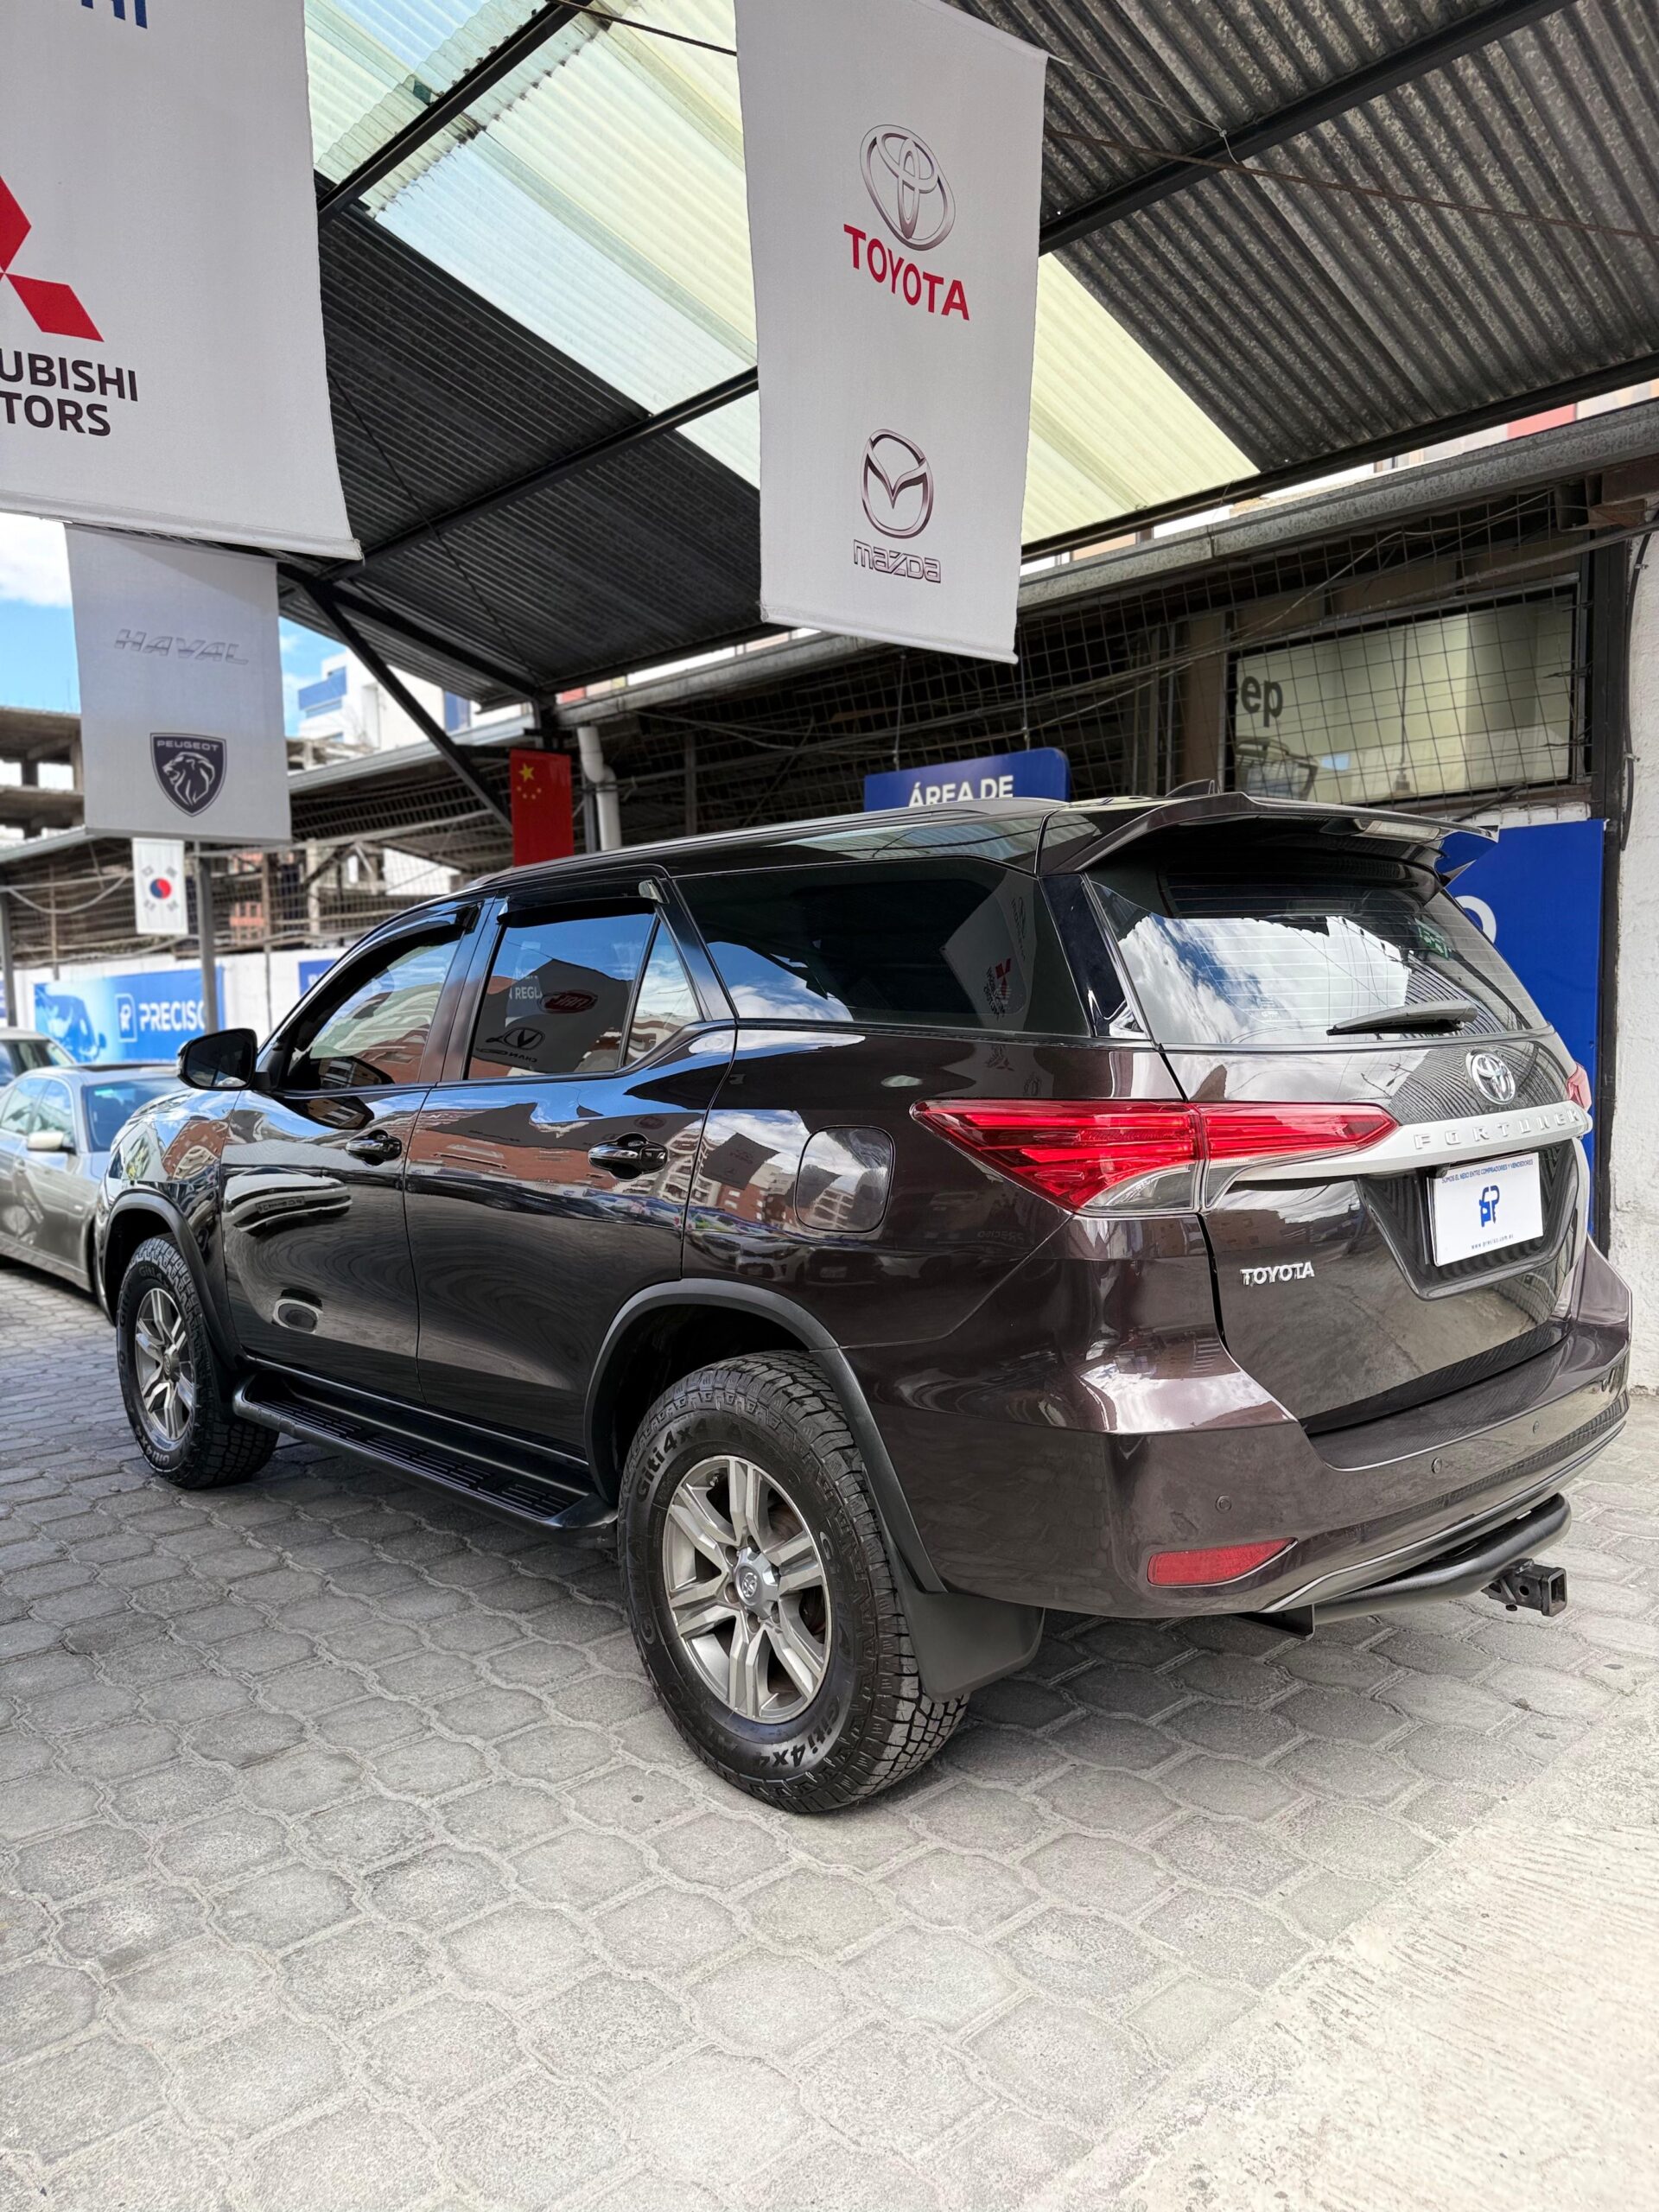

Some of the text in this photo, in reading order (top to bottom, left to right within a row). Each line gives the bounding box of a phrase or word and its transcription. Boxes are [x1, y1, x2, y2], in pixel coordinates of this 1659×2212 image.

[843, 224, 970, 321] TOYOTA
[0, 348, 138, 402] UBISHI
[0, 391, 111, 437] TORS
[114, 628, 249, 665] HAVAL
[156, 740, 219, 752] PEUGEOT
[909, 775, 1014, 808] ÁREA DE
[1414, 1109, 1580, 1150] FORTUNER
[1240, 1261, 1315, 1287] TOYOTA
